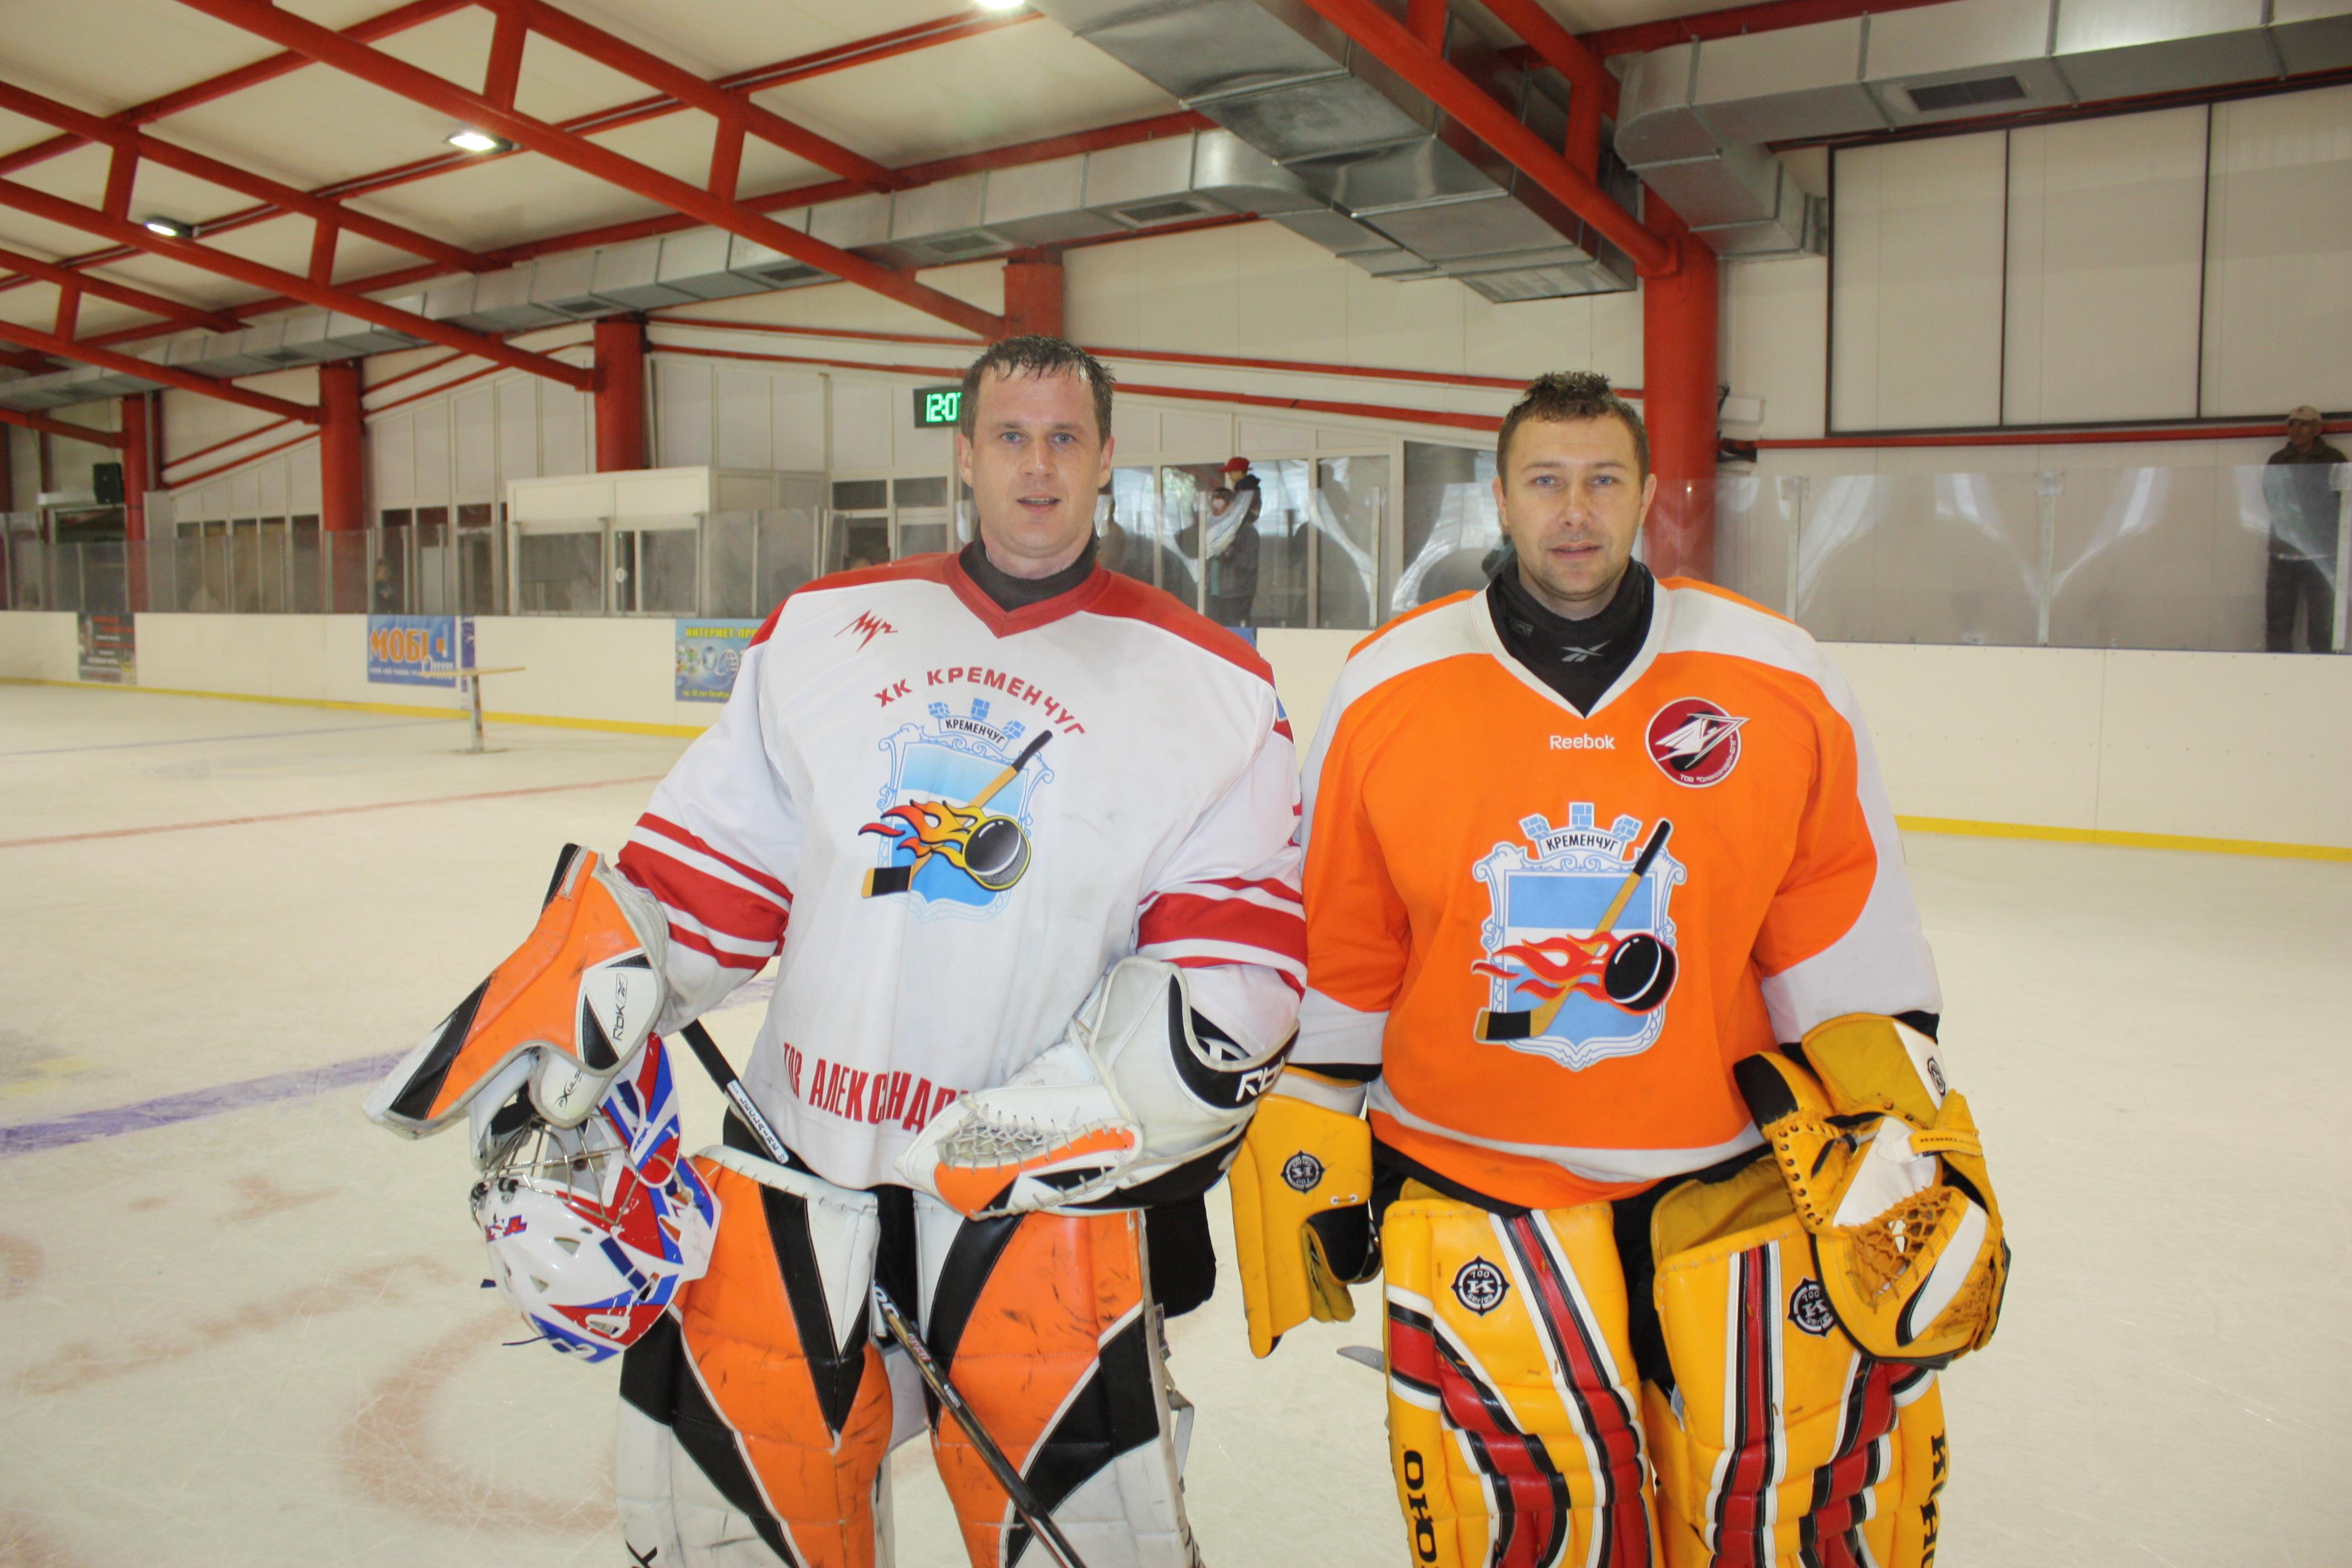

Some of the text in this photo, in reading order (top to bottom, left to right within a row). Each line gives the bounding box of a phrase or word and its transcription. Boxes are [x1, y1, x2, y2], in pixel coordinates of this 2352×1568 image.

[926, 391, 962, 422] 12:0
[873, 666, 1086, 736] ХК КРЕМЕНЧУГ
[945, 718, 1006, 745] КРЕМЕНЧУГ
[1549, 733, 1615, 750] Reebok
[1546, 834, 1619, 853] КРЕМЕНЧУГ
[1470, 1270, 1490, 1279] 100
[1467, 1280, 1495, 1294] K
[1801, 1290, 1820, 1302] 100
[1466, 1292, 1494, 1304] series
[1801, 1298, 1828, 1318] K
[1403, 1450, 1438, 1568] OHO
